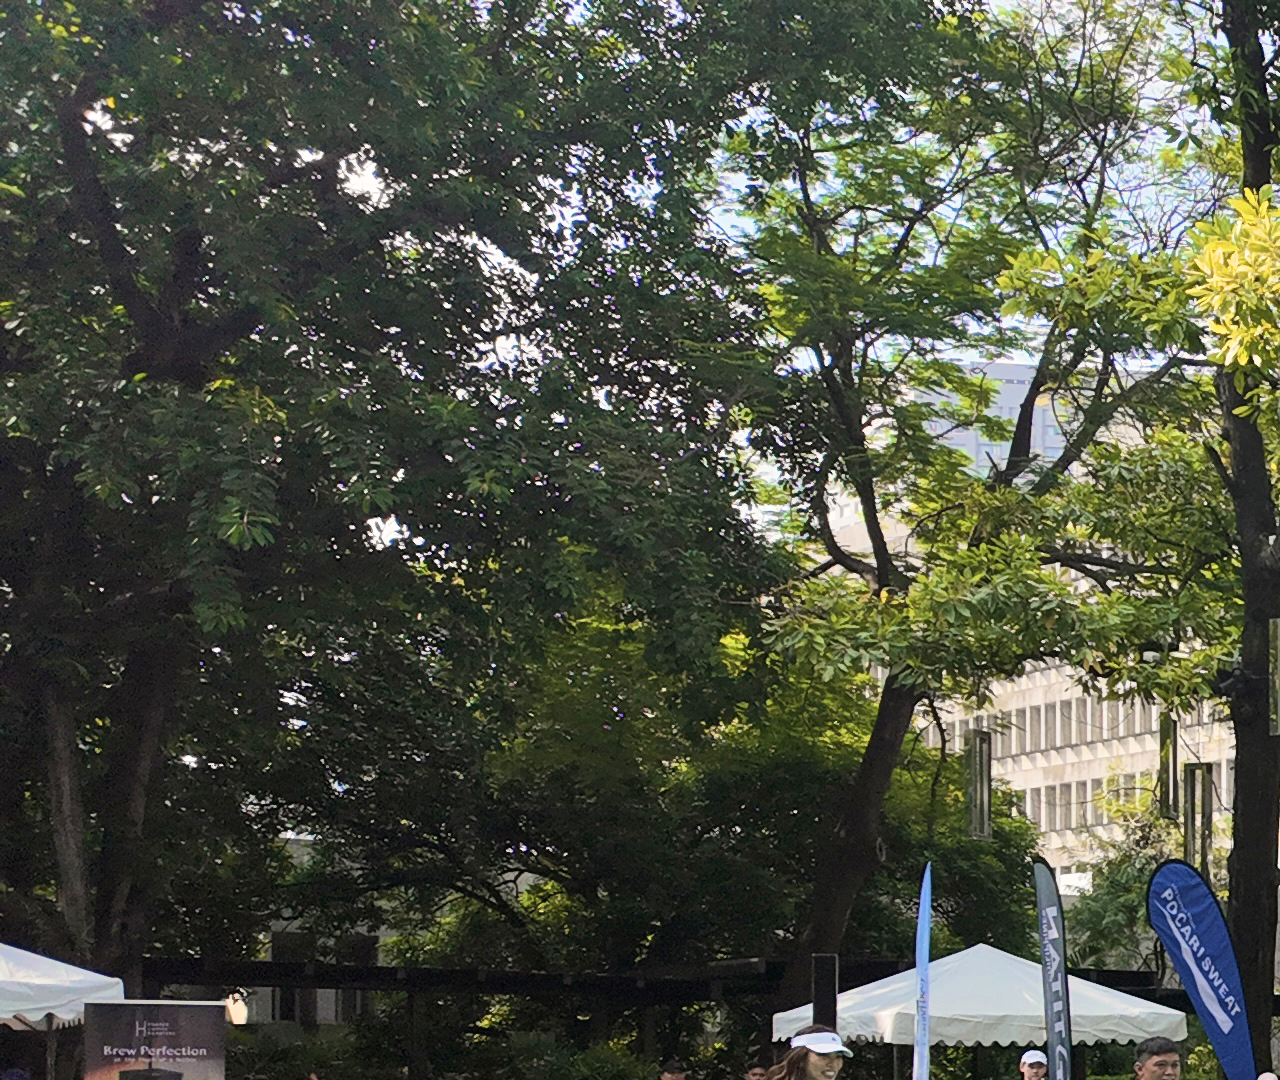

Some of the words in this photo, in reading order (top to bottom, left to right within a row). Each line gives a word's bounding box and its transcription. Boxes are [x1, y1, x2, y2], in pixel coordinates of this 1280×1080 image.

[1160, 887, 1206, 958] POCARI
[1201, 956, 1242, 1017] SWEAT
[103, 1045, 137, 1056] Brew
[140, 1045, 207, 1056] Perfection
